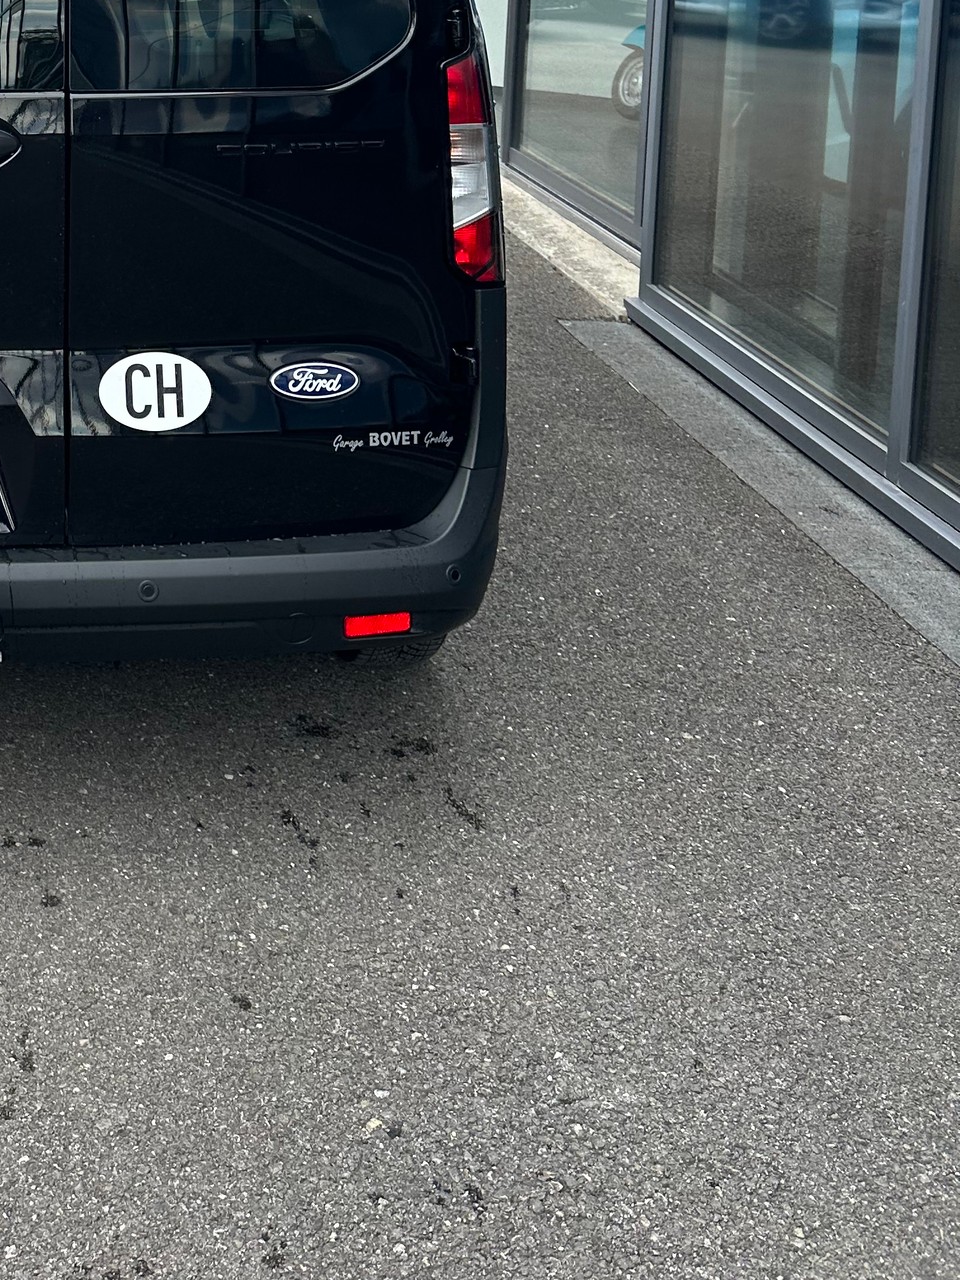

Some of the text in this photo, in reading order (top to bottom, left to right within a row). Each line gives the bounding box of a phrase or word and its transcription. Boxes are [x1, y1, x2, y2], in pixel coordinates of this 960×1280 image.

[124, 363, 185, 420] CH
[288, 367, 342, 393] Ford
[332, 430, 454, 452] Garage BOVET Grolley
